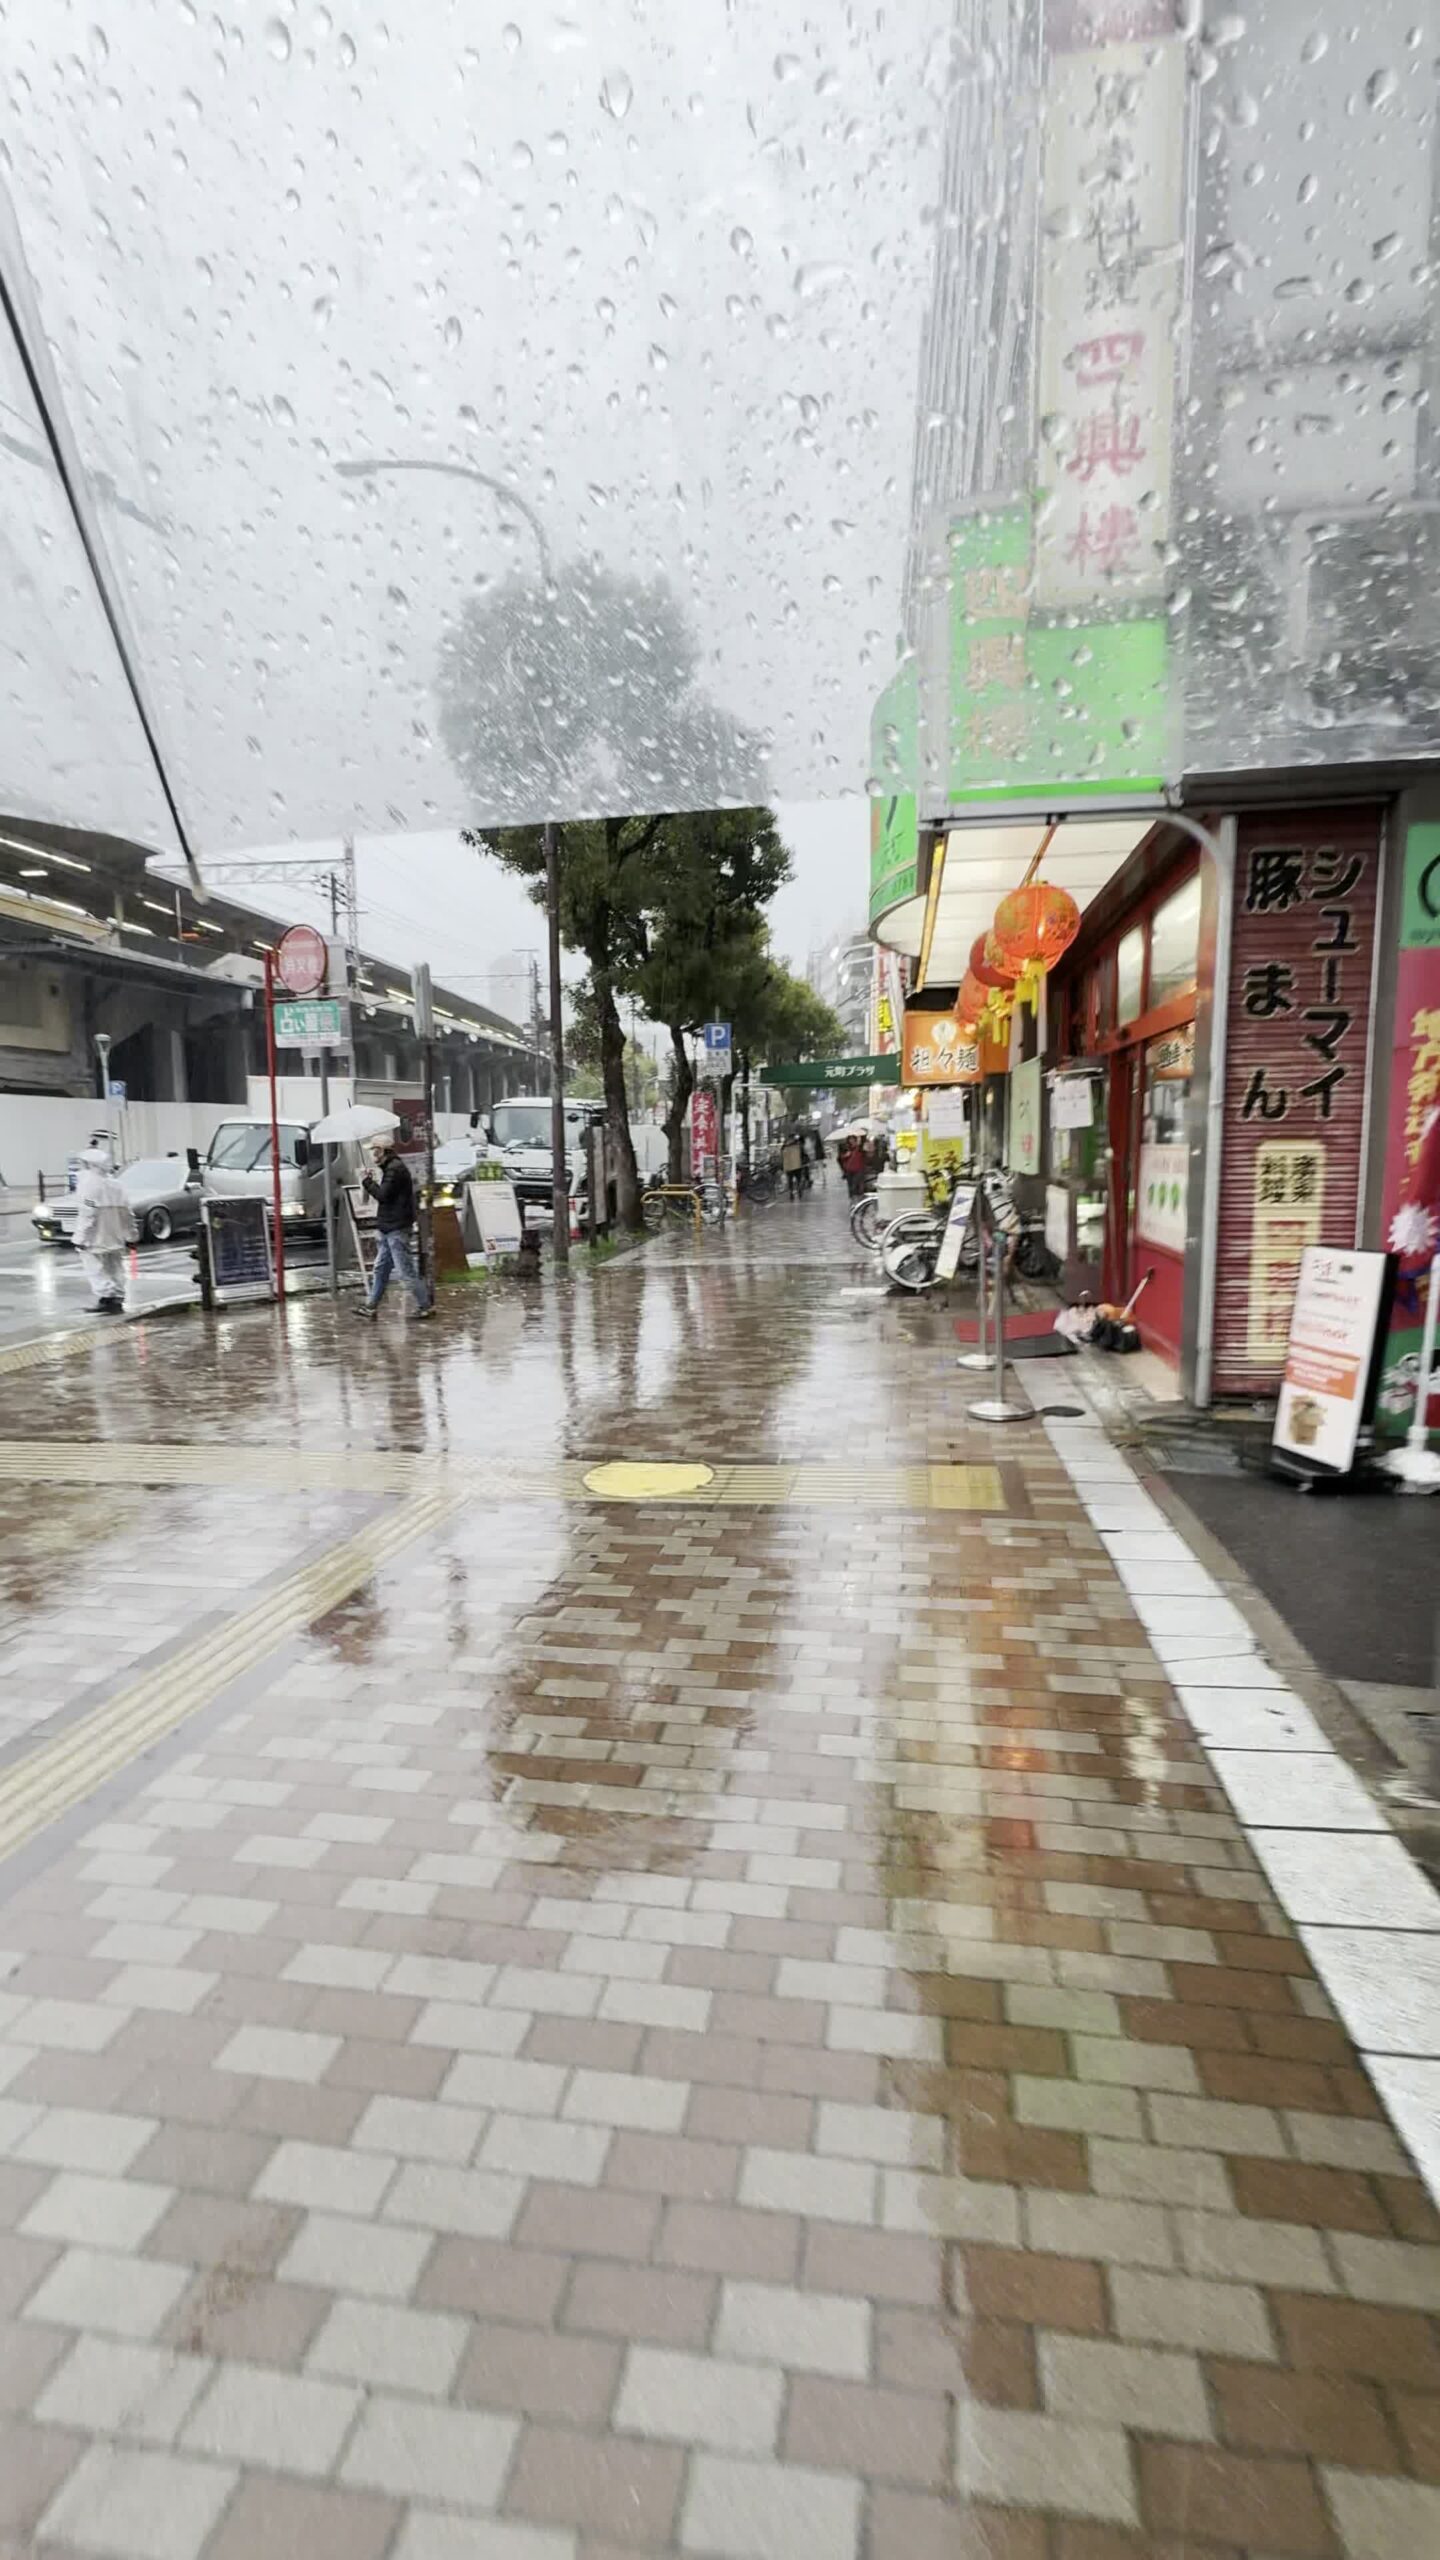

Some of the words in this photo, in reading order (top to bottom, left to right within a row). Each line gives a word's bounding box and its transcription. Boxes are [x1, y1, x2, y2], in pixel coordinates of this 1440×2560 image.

[824, 1064, 876, 1079] 元町プラザ
[1241, 848, 1304, 1121] 豚まん
[1300, 846, 1366, 1119] シューマイ
